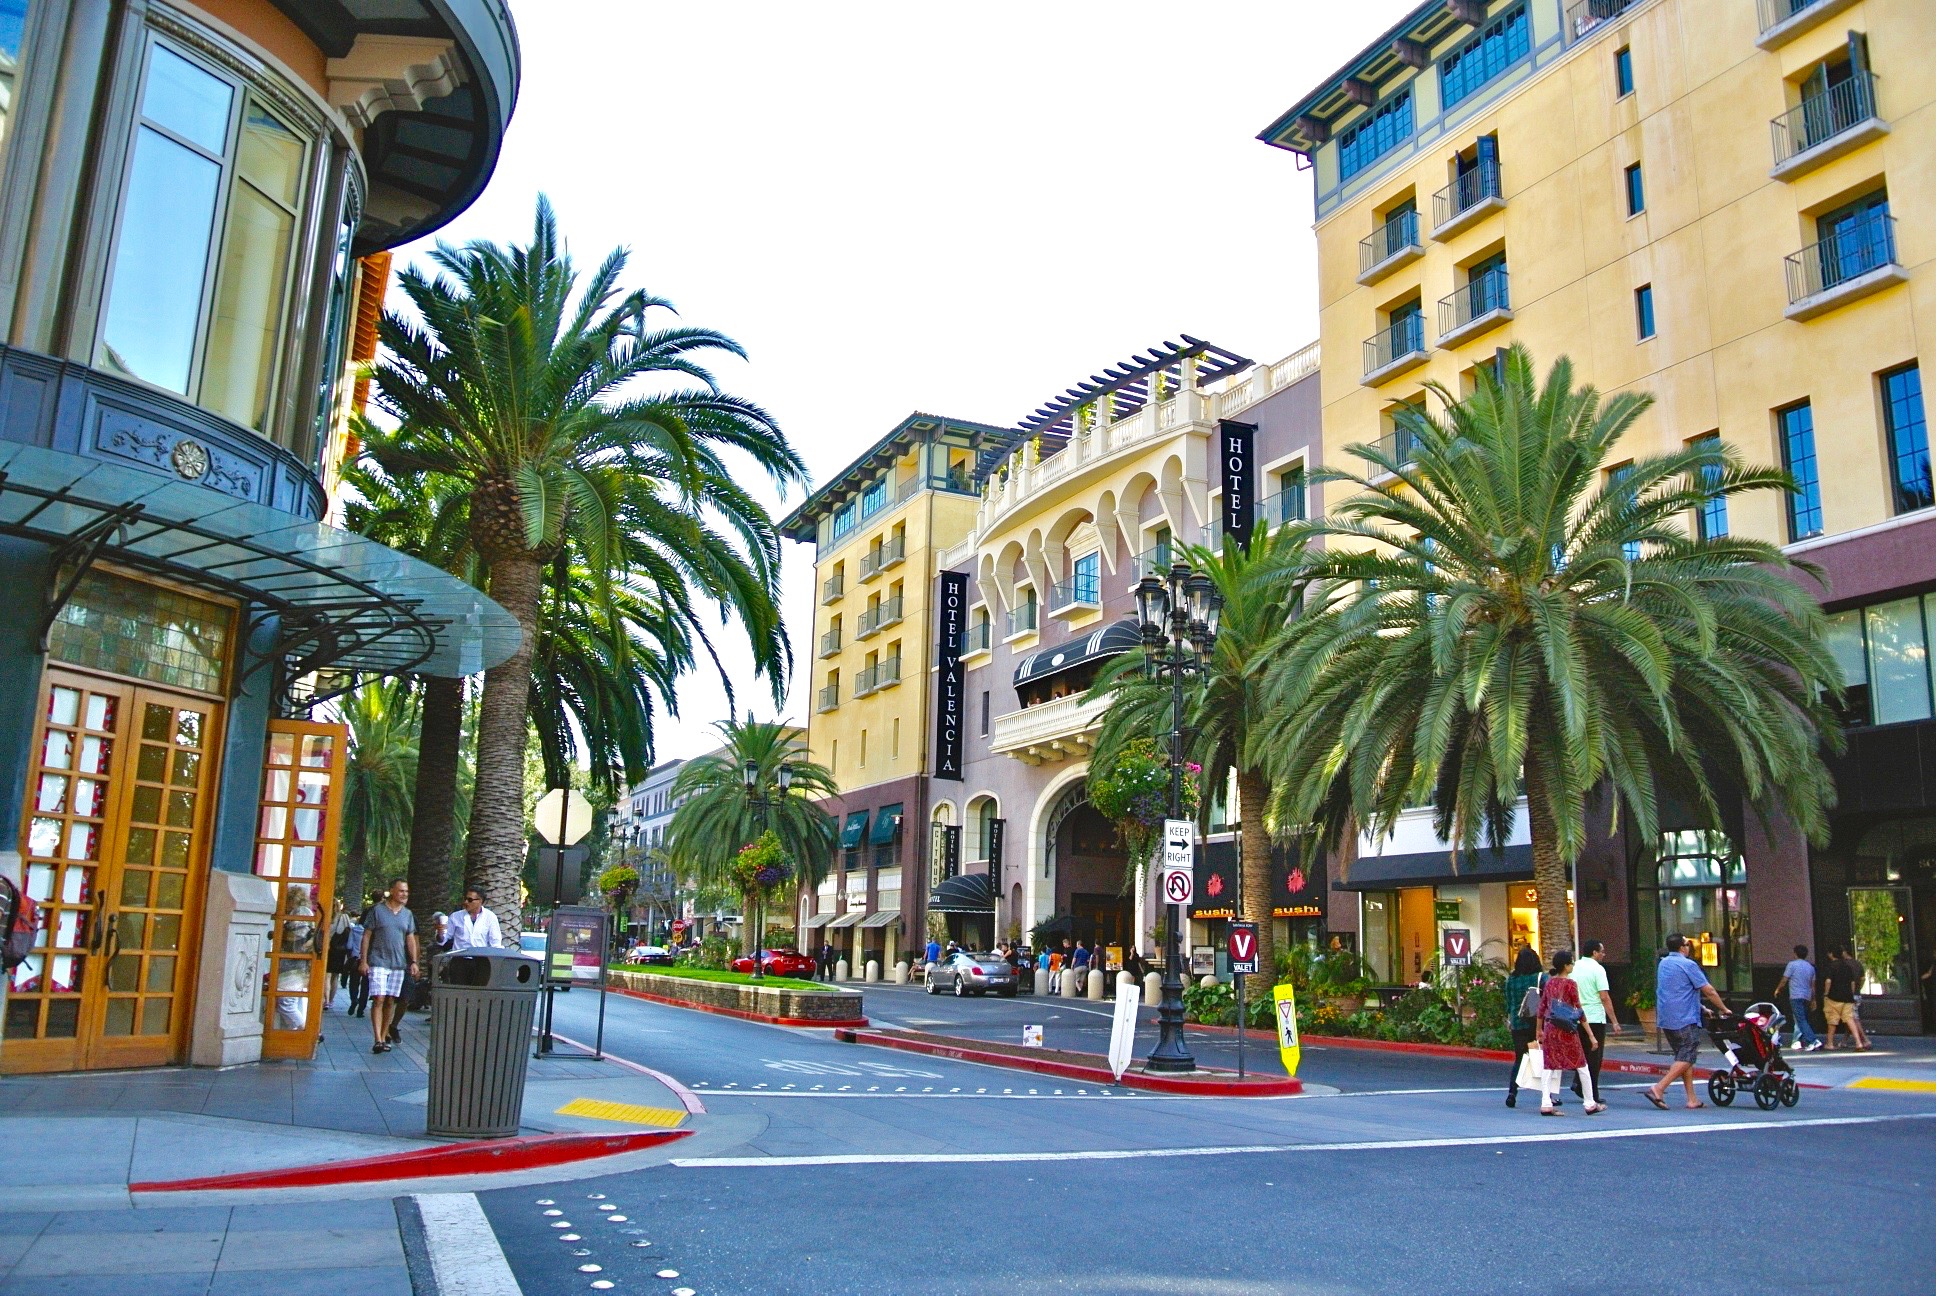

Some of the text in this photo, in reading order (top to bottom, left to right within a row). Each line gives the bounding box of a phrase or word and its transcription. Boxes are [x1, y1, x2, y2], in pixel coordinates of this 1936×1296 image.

[1229, 437, 1243, 529] HOTEL
[943, 582, 958, 771] HOTEL VALENCIA
[1169, 826, 1190, 837] KEEP
[1167, 852, 1192, 864] RIGHT
[1195, 908, 1234, 916] sushi
[1274, 905, 1319, 914] sushi
[1234, 934, 1251, 958] V
[1450, 938, 1464, 955] V
